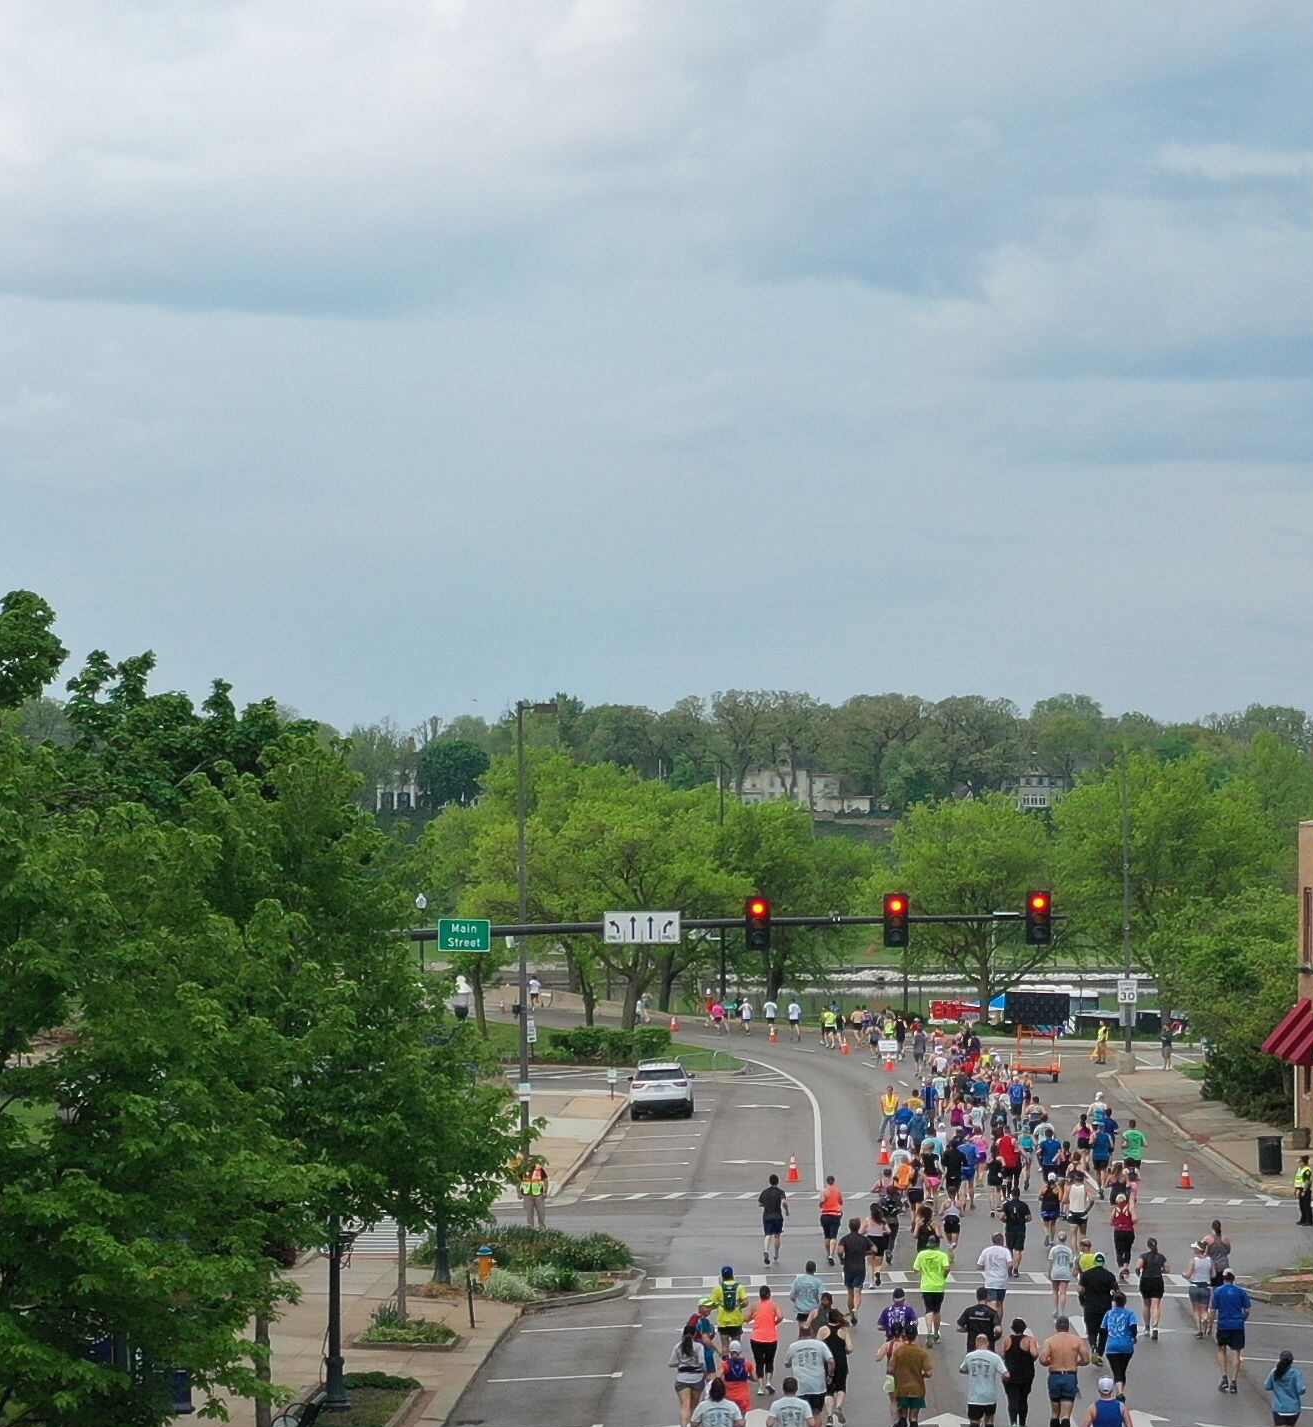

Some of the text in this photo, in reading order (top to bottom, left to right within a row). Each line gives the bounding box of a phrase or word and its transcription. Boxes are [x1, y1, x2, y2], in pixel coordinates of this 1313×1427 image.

[451, 923, 477, 934] Main
[447, 937, 481, 948] Street
[1120, 992, 1135, 1001] 30
